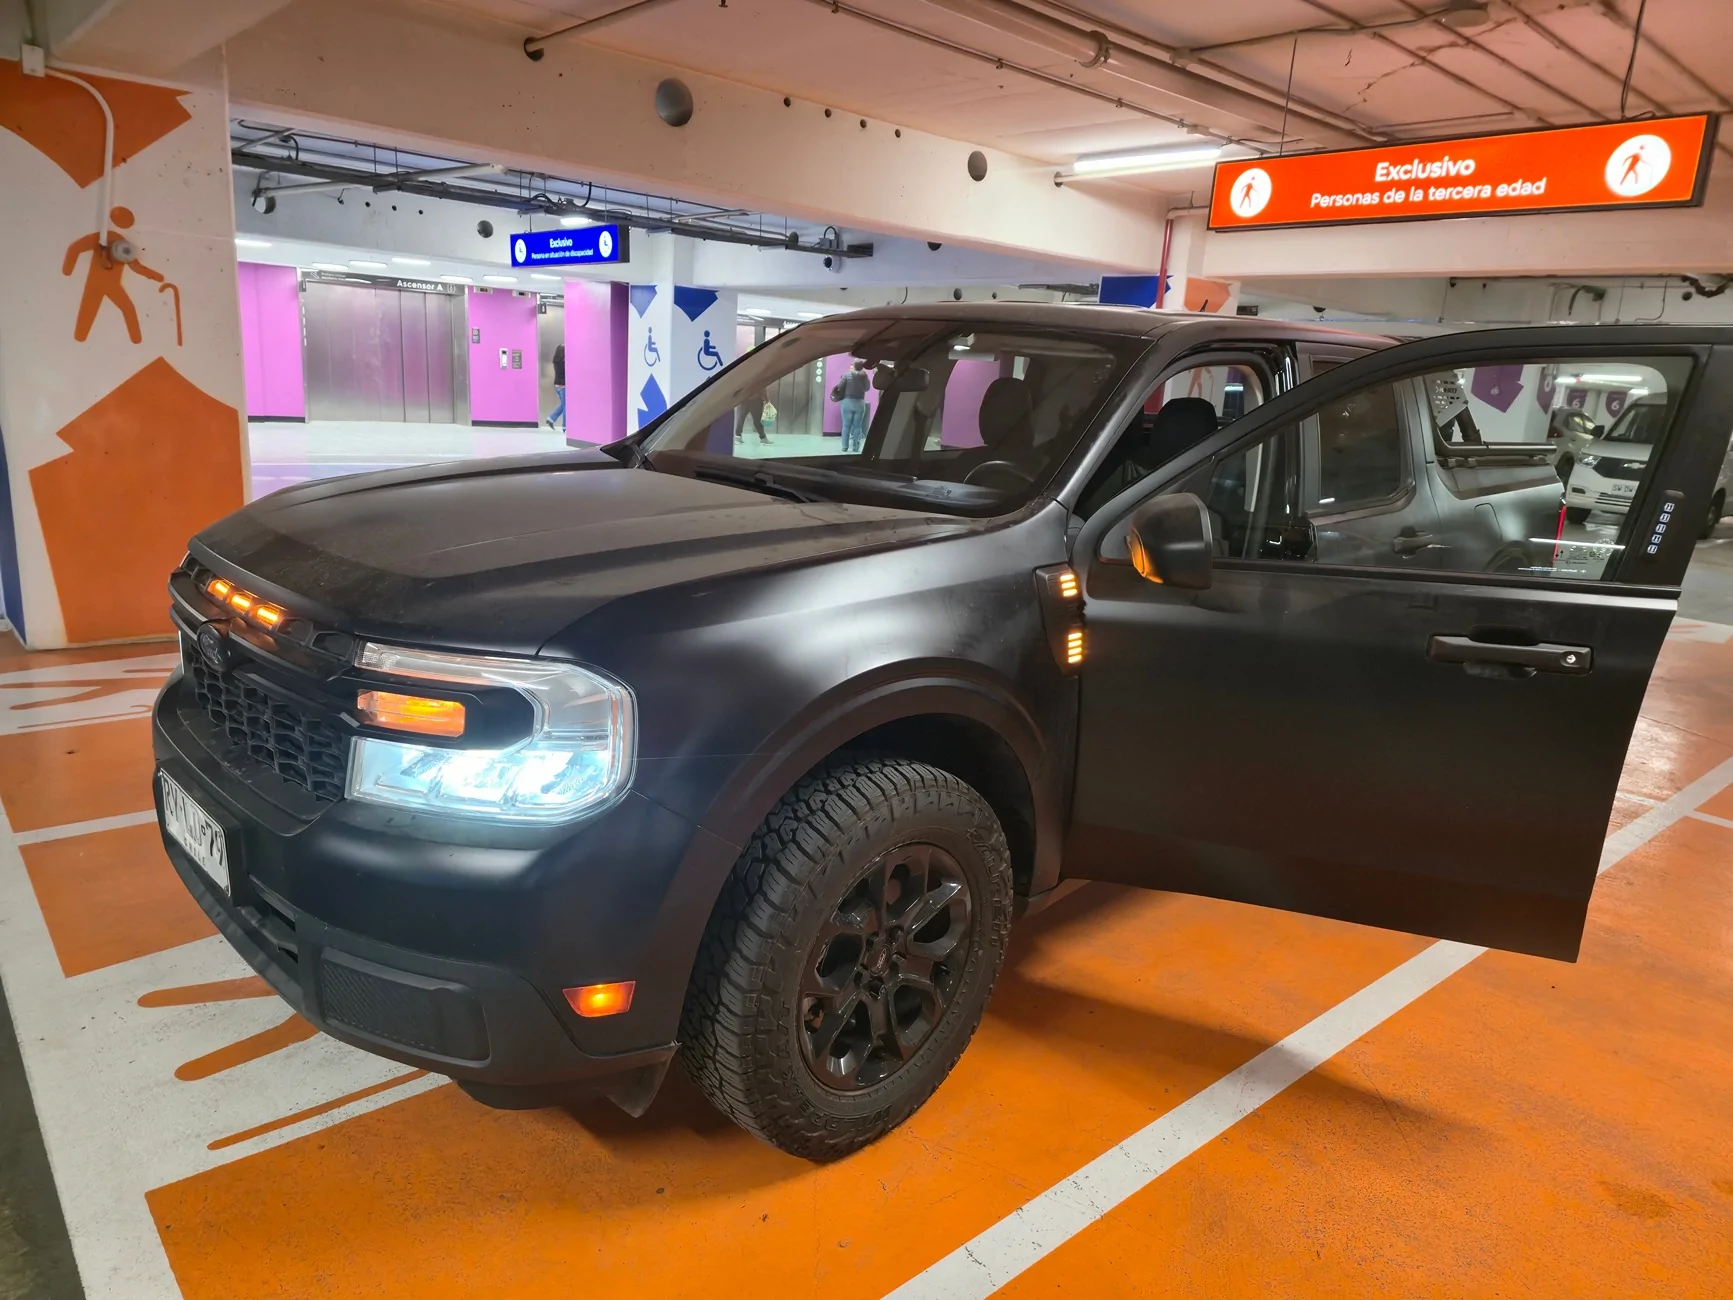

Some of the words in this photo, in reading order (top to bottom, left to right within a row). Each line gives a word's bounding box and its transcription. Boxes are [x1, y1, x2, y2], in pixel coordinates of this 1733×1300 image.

[1374, 155, 1476, 182] Exclusivo
[1310, 192, 1380, 208] Personas
[1383, 187, 1406, 204] de
[1409, 186, 1424, 202] la
[1428, 185, 1492, 201] tercera
[1496, 177, 1547, 197] edad
[549, 237, 573, 248] Exclusivo
[397, 279, 435, 290] Ascensor
[436, 283, 444, 291] A
[1611, 400, 1621, 410] 6
